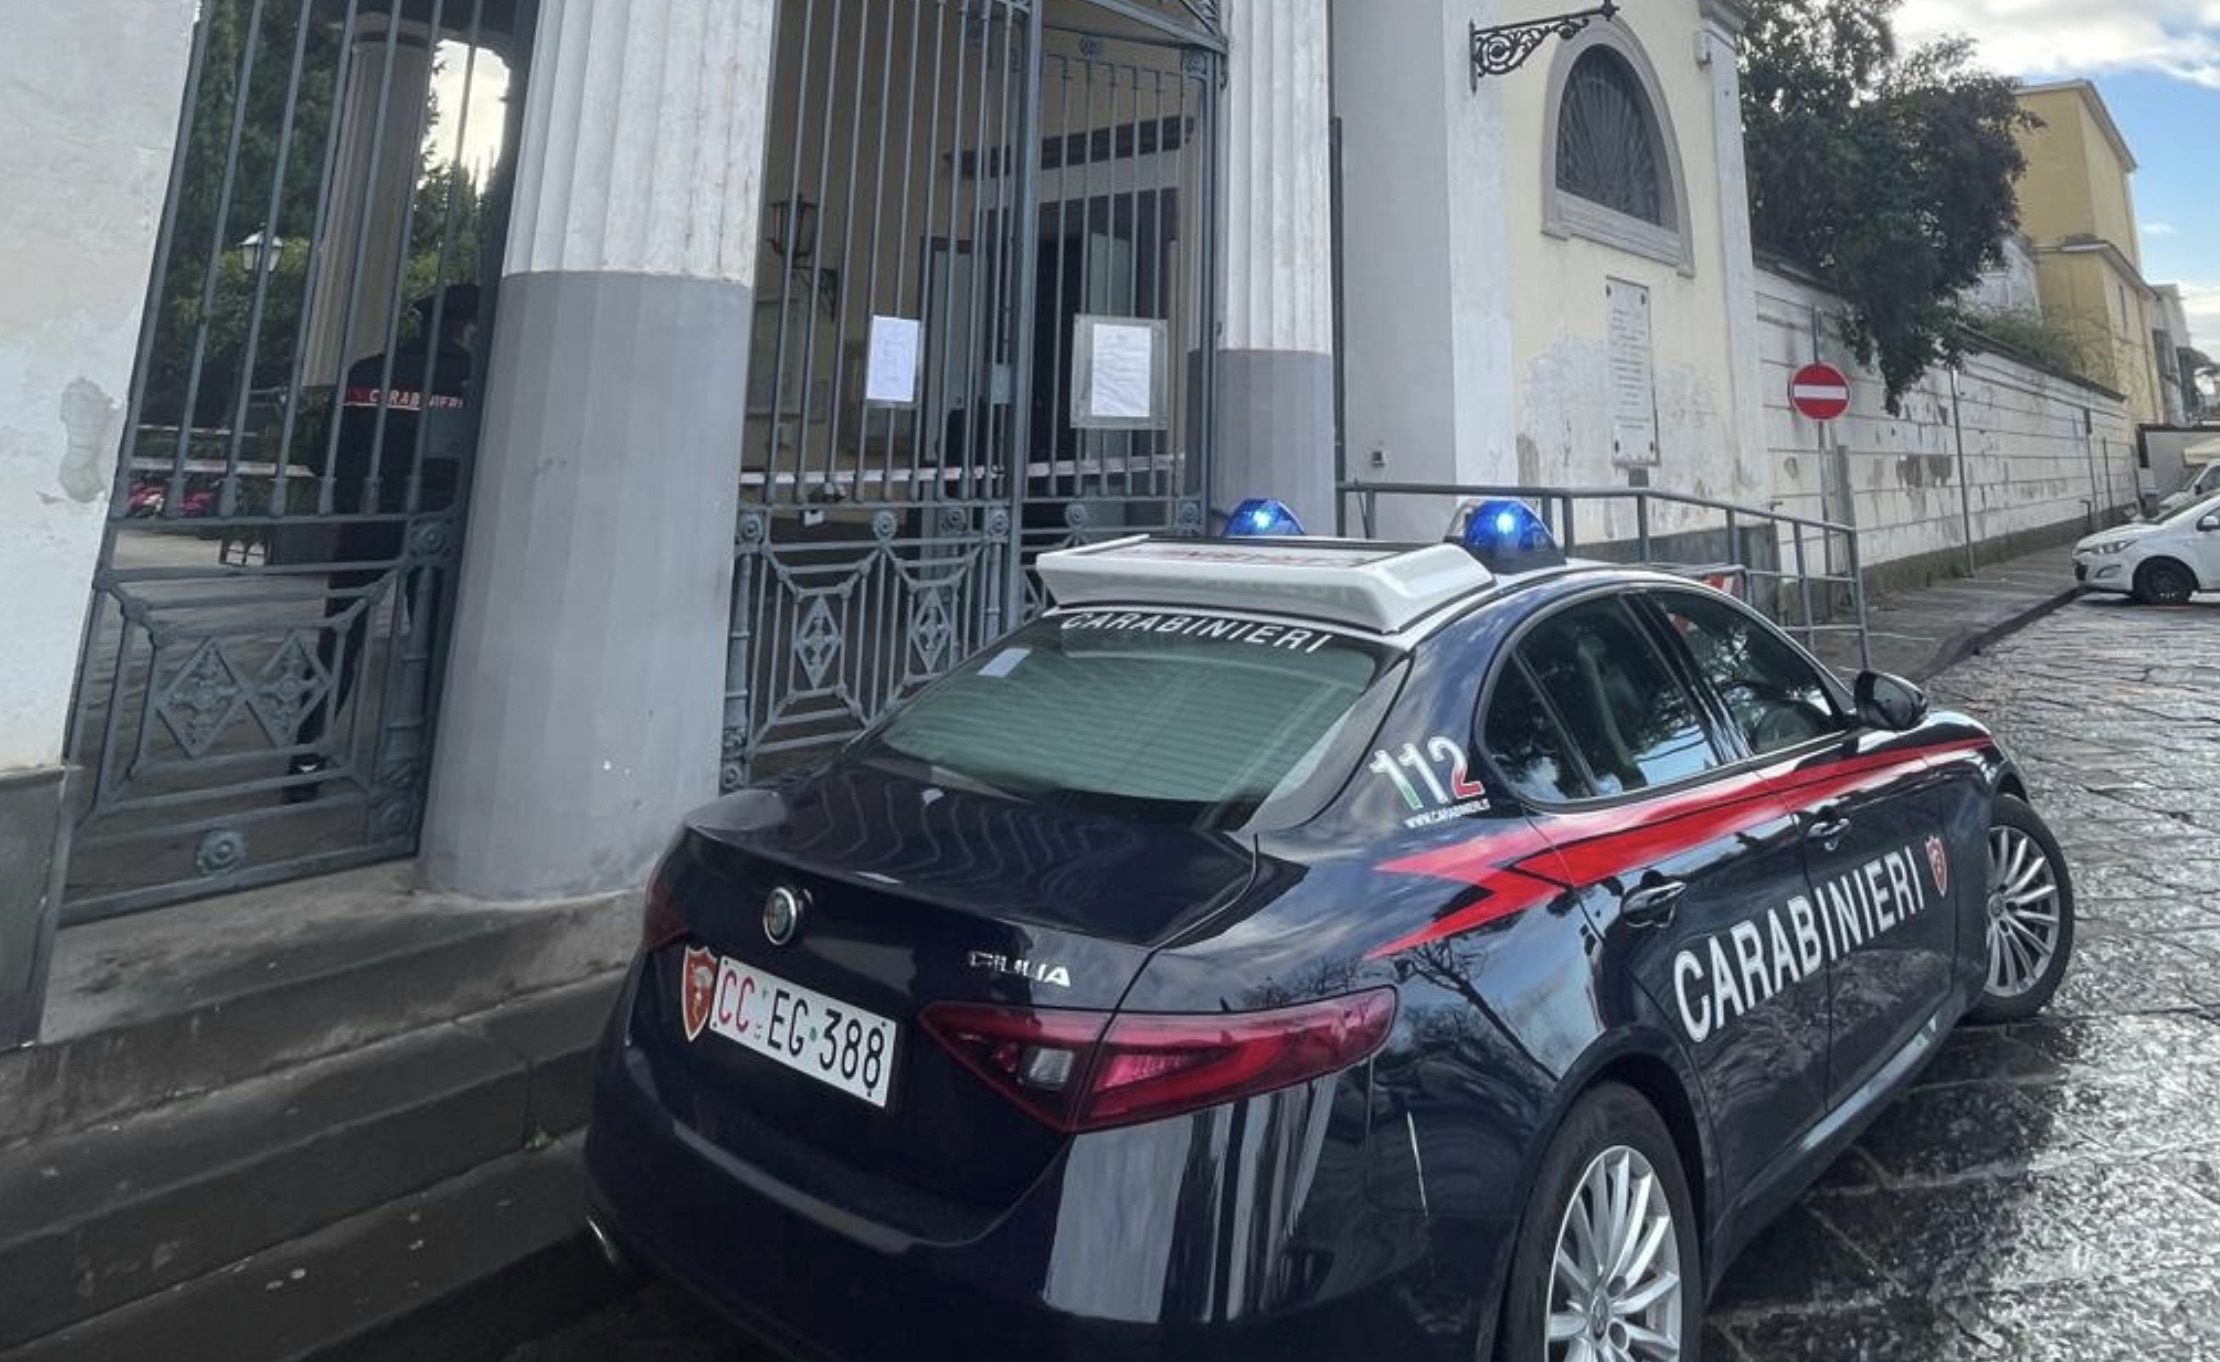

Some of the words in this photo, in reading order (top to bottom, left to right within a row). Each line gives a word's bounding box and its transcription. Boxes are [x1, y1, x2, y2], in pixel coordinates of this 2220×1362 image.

[1061, 612, 1333, 653] CARABINIERI
[1369, 736, 1485, 810] 112
[1674, 846, 1924, 1042] CARABINIERI
[719, 970, 755, 1032] CC
[768, 987, 808, 1056] EG
[820, 1008, 885, 1088] 388
